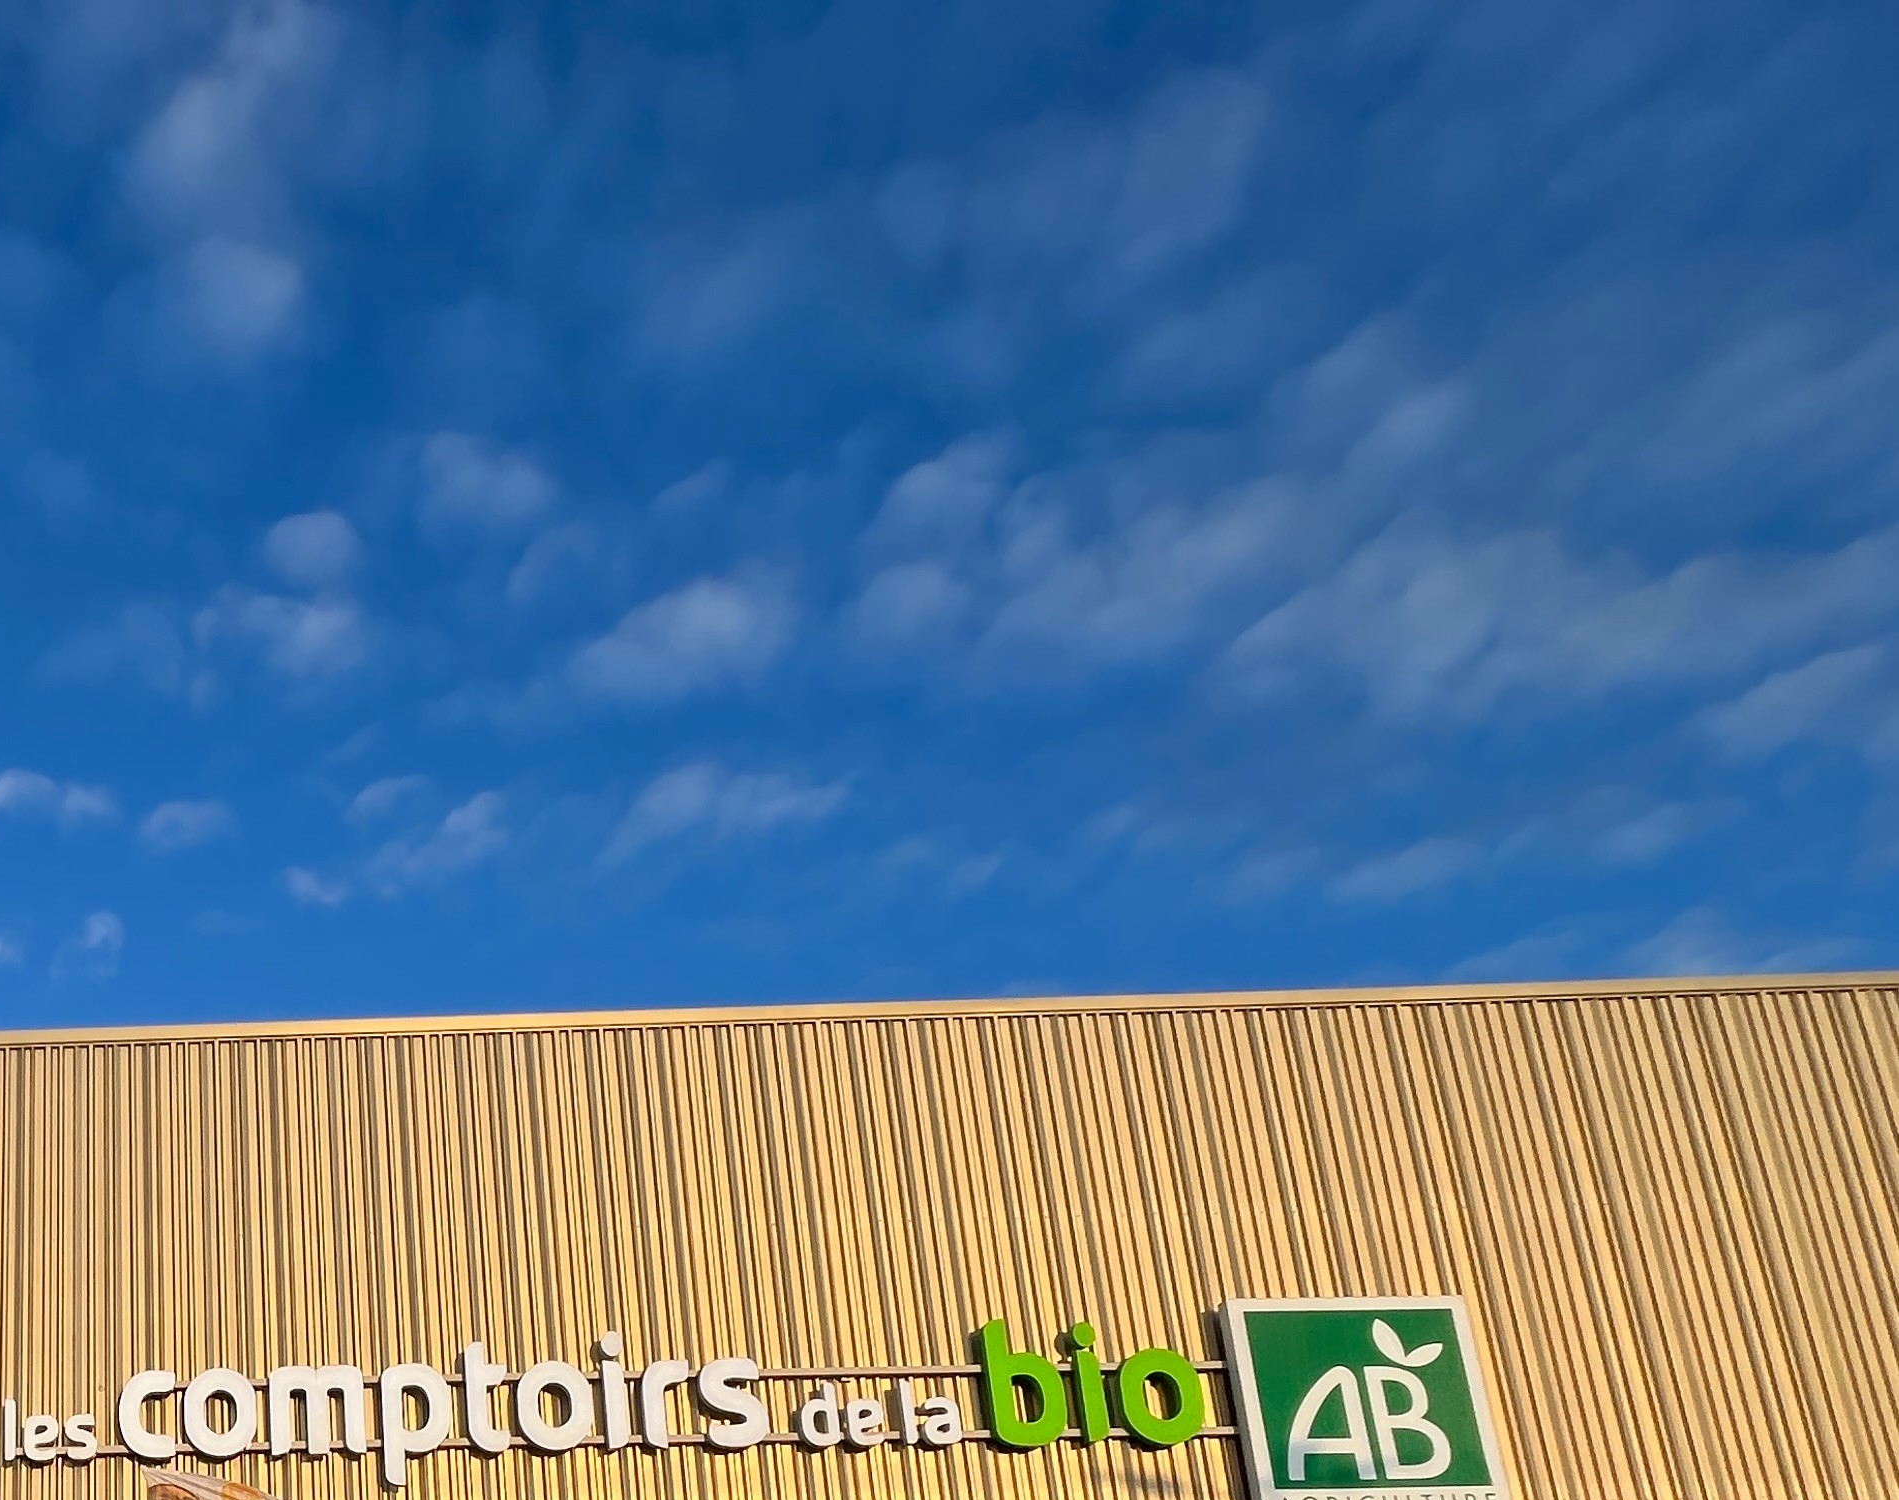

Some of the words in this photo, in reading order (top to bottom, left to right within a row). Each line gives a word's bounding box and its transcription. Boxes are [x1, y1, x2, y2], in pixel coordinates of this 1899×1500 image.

[3, 1398, 96, 1462] les
[118, 1331, 768, 1487] comptoirs
[801, 1380, 886, 1448] de
[901, 1378, 961, 1446] la
[981, 1317, 1205, 1449] bio
[1287, 1366, 1451, 1481] AB
